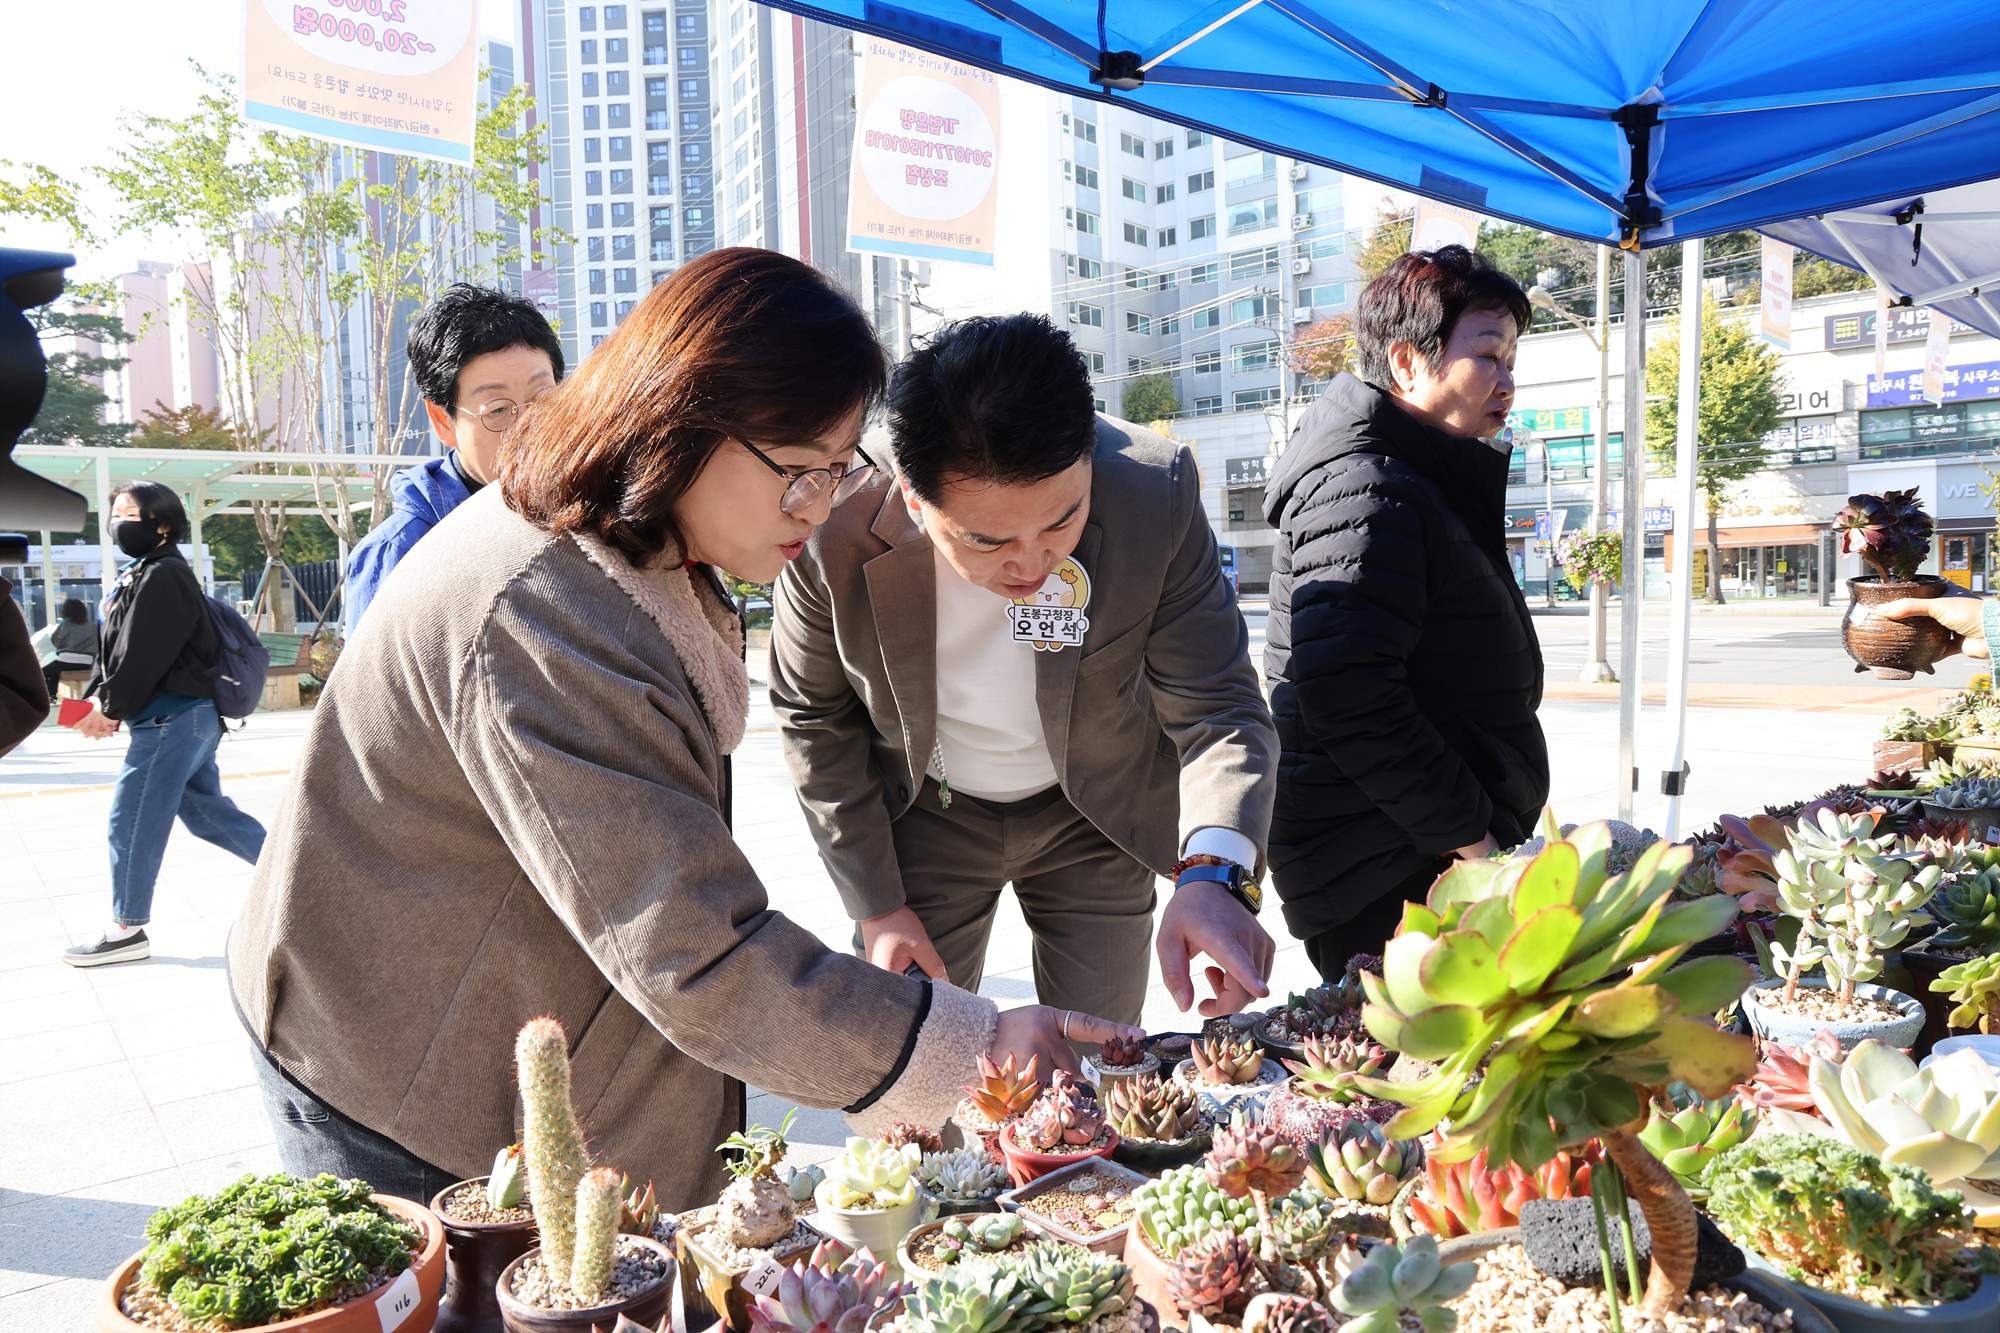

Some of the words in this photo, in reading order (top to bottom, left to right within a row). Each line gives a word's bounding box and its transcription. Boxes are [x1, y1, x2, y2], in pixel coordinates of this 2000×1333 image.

[1908, 369, 1960, 391] 원복
[1020, 608, 1074, 621] 도봉구청장
[754, 1266, 776, 1290] 225
[394, 1293, 411, 1313] 116
